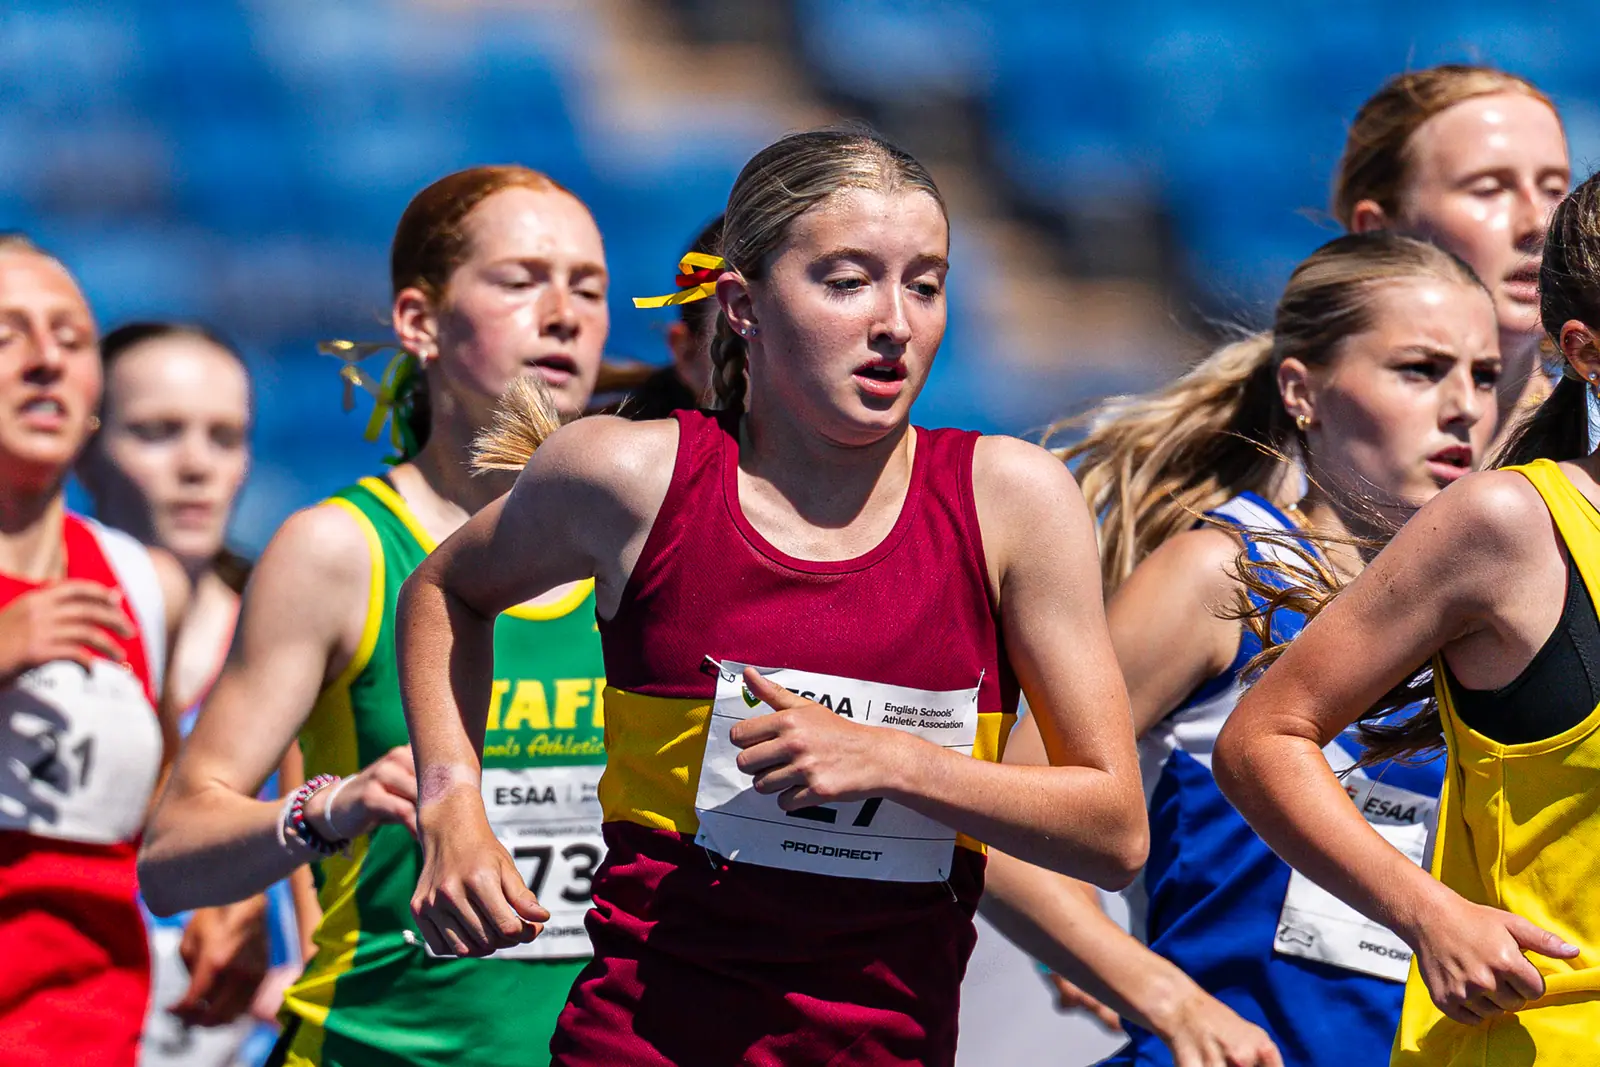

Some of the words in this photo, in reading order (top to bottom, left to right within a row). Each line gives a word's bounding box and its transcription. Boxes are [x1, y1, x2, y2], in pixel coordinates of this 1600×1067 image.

[884, 702, 918, 716] English
[919, 707, 954, 718] Schools'
[881, 715, 917, 727] Athletic
[918, 719, 964, 729] Association
[494, 785, 557, 805] ESAA
[1363, 797, 1416, 823] ESAA
[780, 840, 883, 861] PRO:DIRECT
[513, 843, 602, 903] 73
